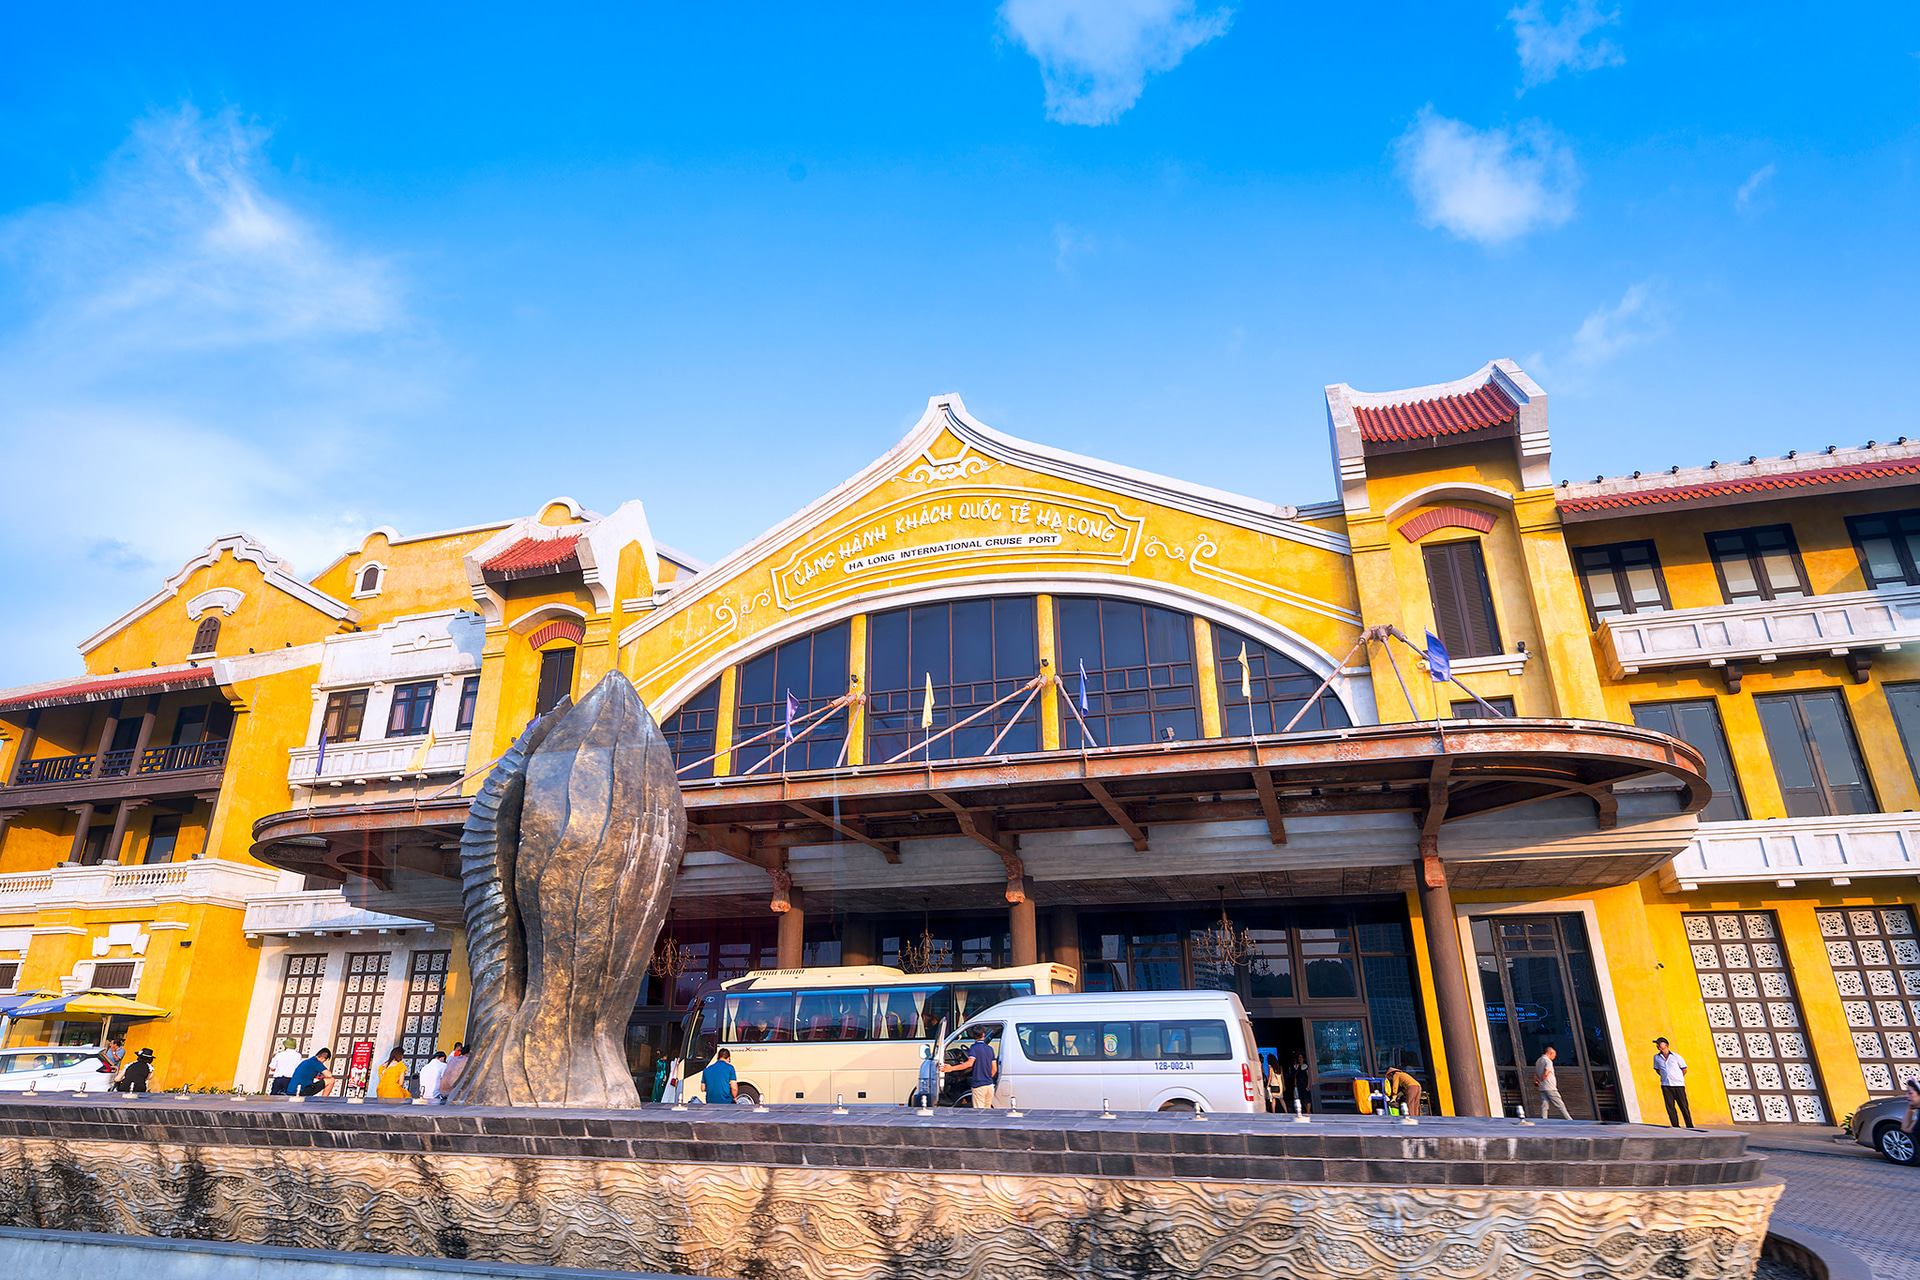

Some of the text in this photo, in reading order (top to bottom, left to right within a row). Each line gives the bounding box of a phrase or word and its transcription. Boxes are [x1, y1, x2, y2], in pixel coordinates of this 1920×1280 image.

[793, 498, 1116, 586] CẢNG HÀNH KHÁCH QUỐC TẾ HẠ LONG
[848, 535, 1058, 571] HA LONG INTERNATIONAL CRUISE PORT
